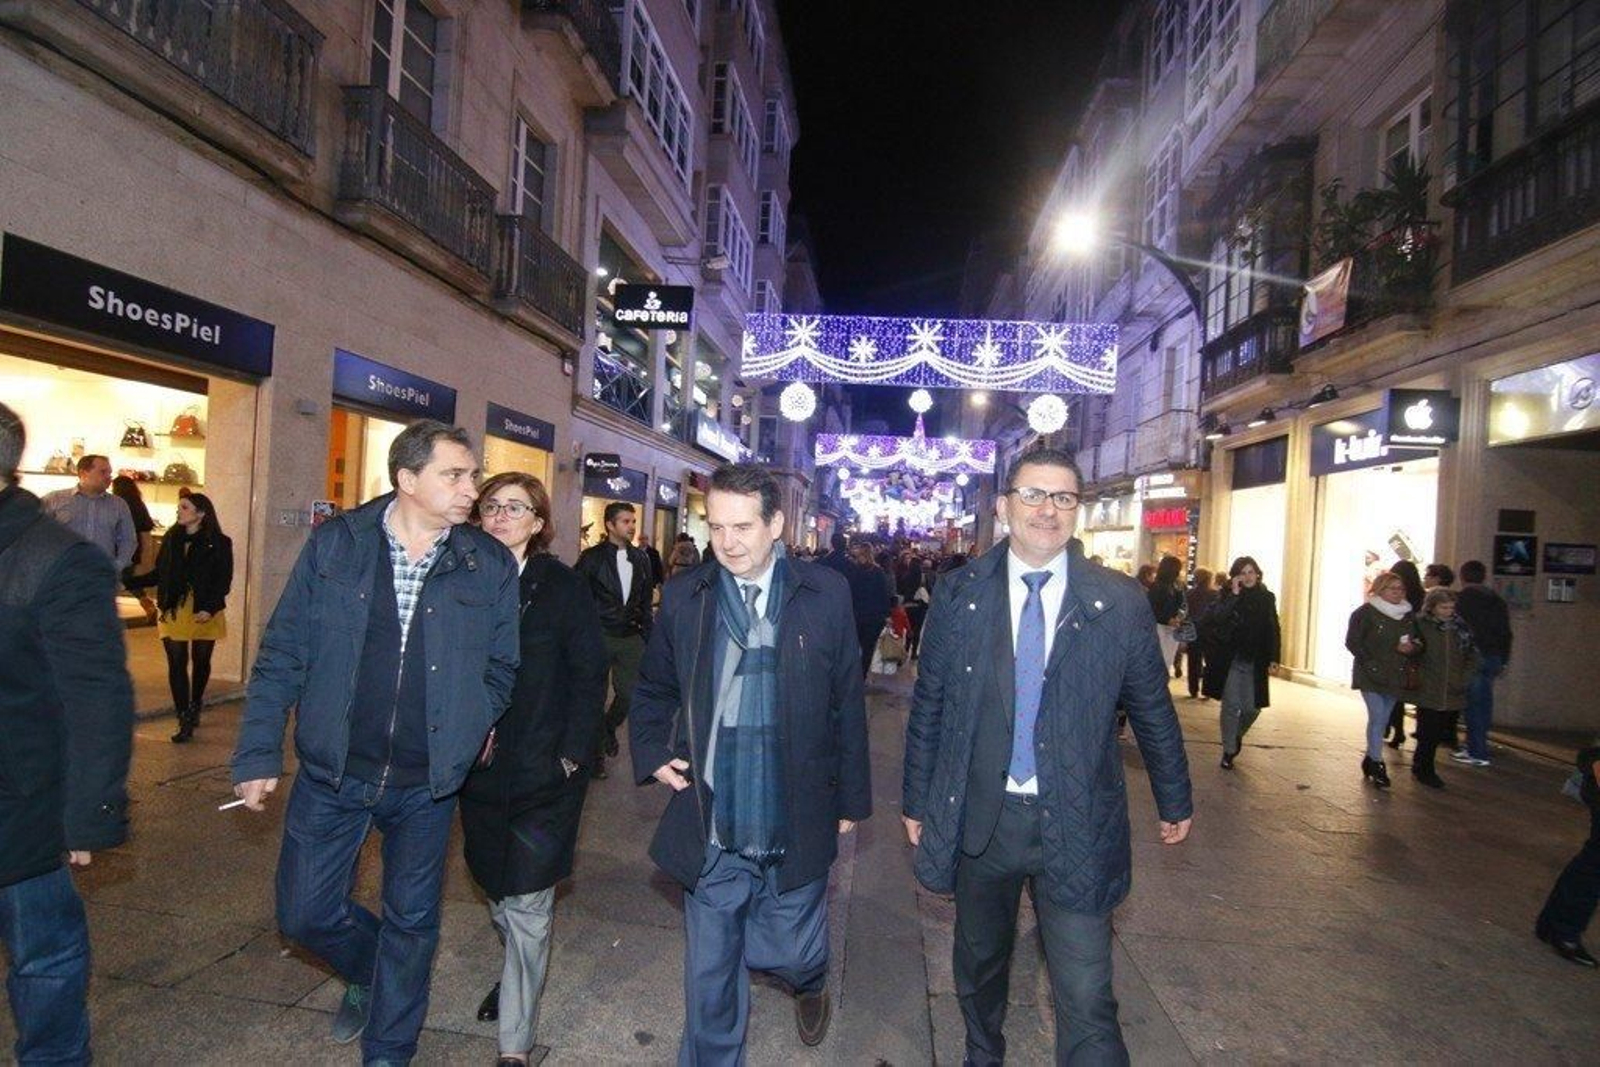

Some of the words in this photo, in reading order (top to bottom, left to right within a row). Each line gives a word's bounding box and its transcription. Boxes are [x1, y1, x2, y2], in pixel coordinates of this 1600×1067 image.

[88, 285, 221, 345] ShoesPiel
[368, 374, 430, 407] ShoesPiel
[505, 418, 540, 439] ShoesPiel
